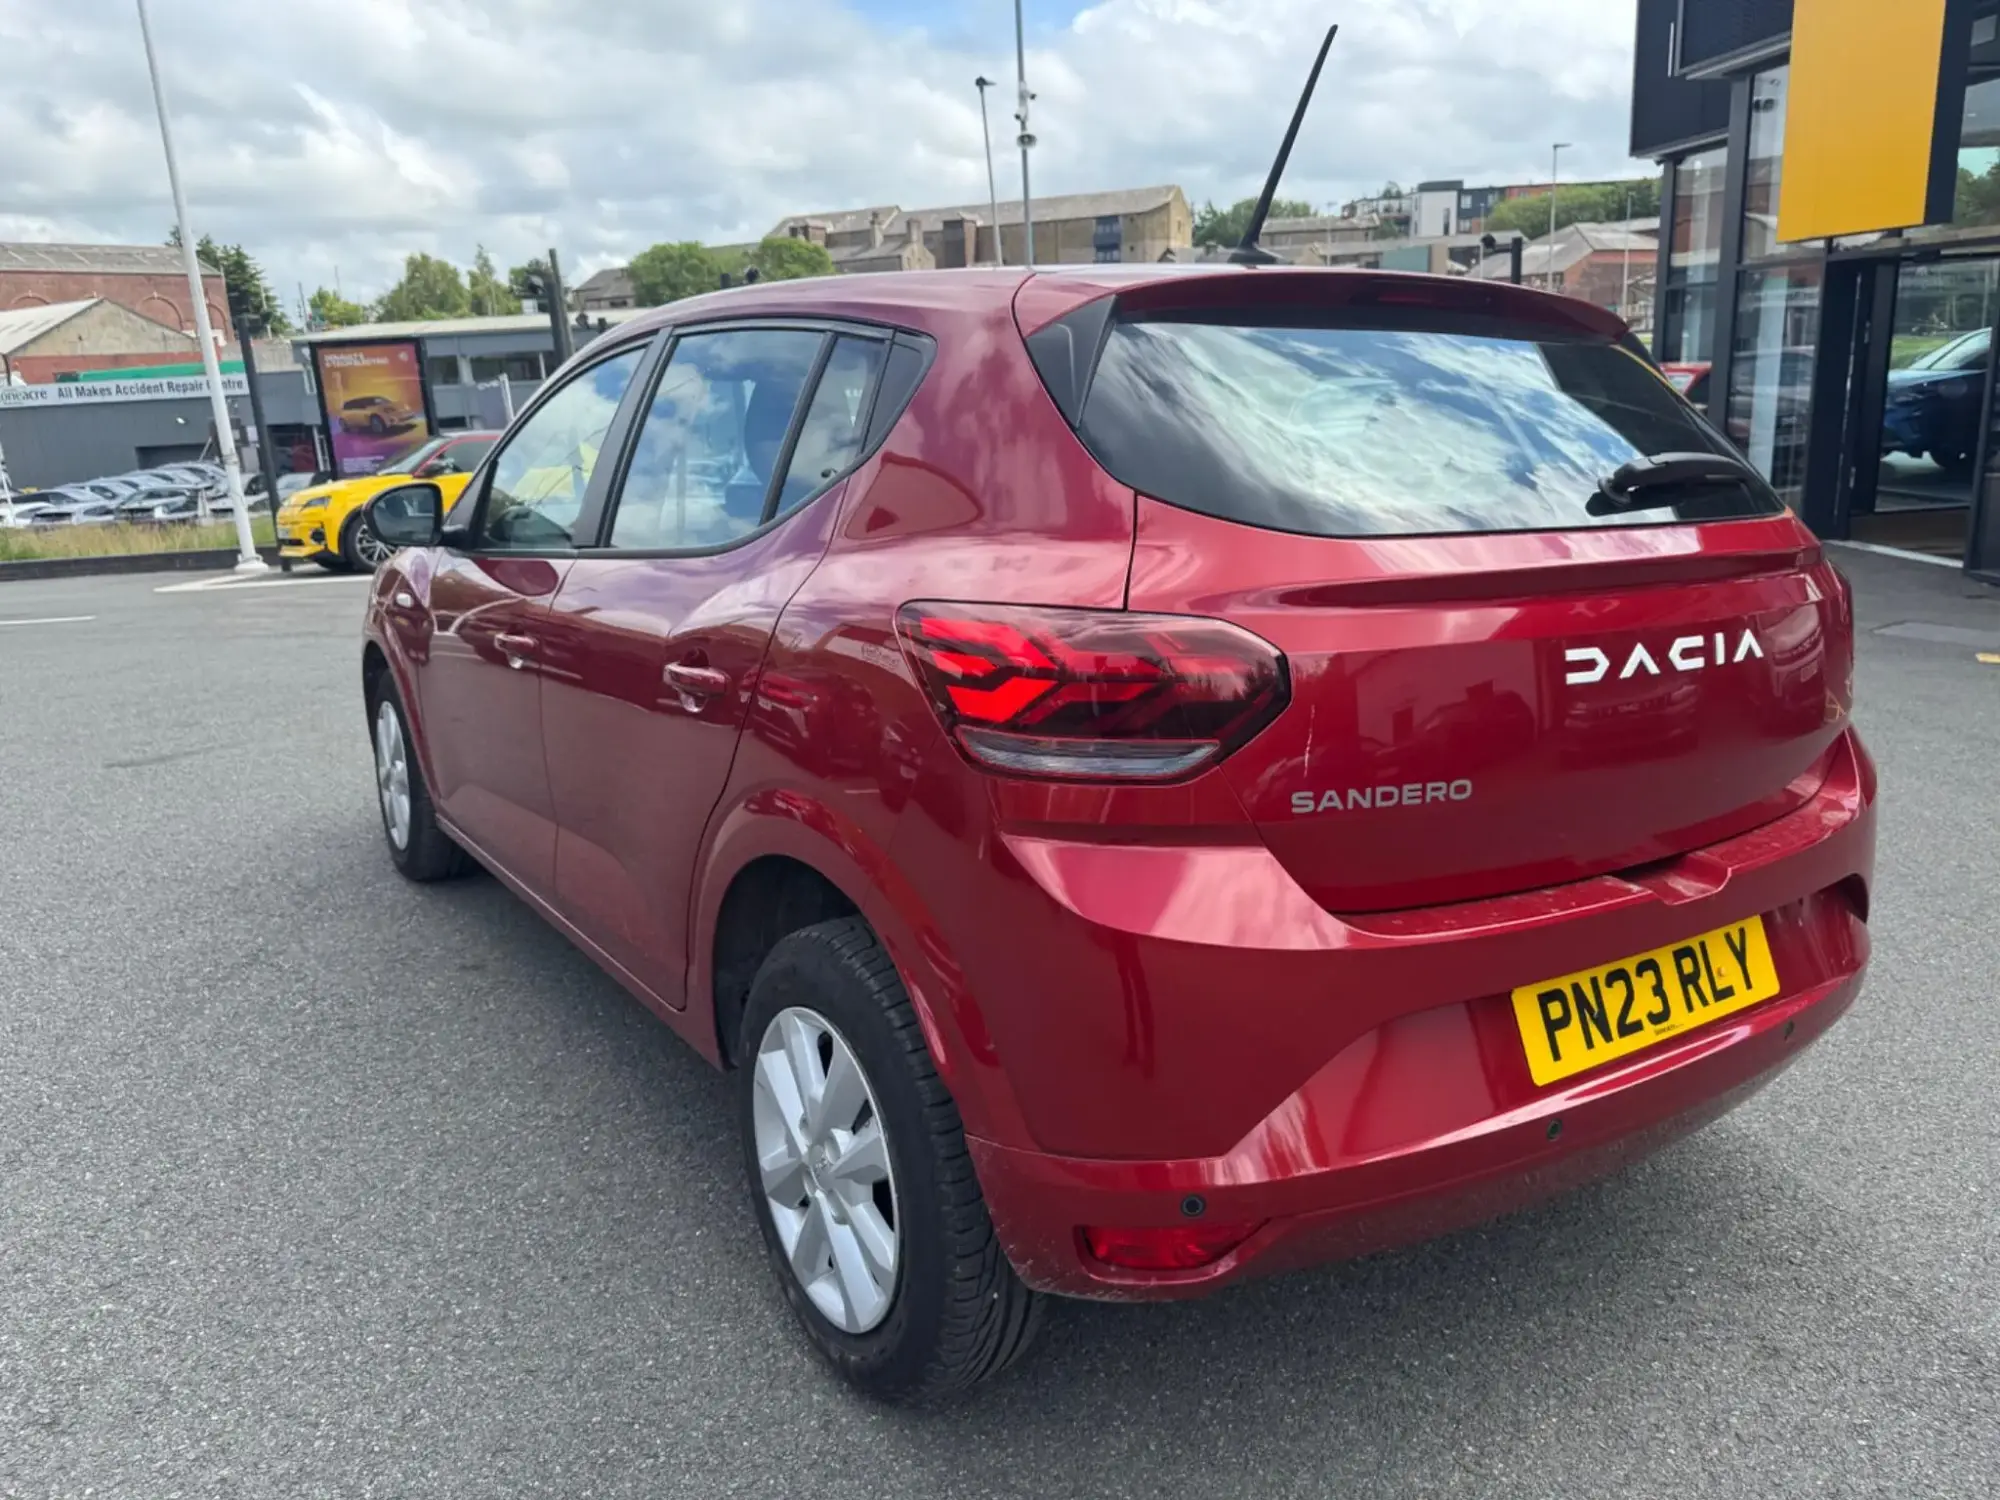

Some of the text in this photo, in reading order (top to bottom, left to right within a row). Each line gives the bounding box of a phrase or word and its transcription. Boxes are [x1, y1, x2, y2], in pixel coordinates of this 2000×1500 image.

[57, 379, 244, 398] All Makes Accident Repair ntre
[1565, 629, 1765, 685] DACIA
[1291, 779, 1472, 813] SANDERO
[1536, 927, 1753, 1062] PN23 RLY
